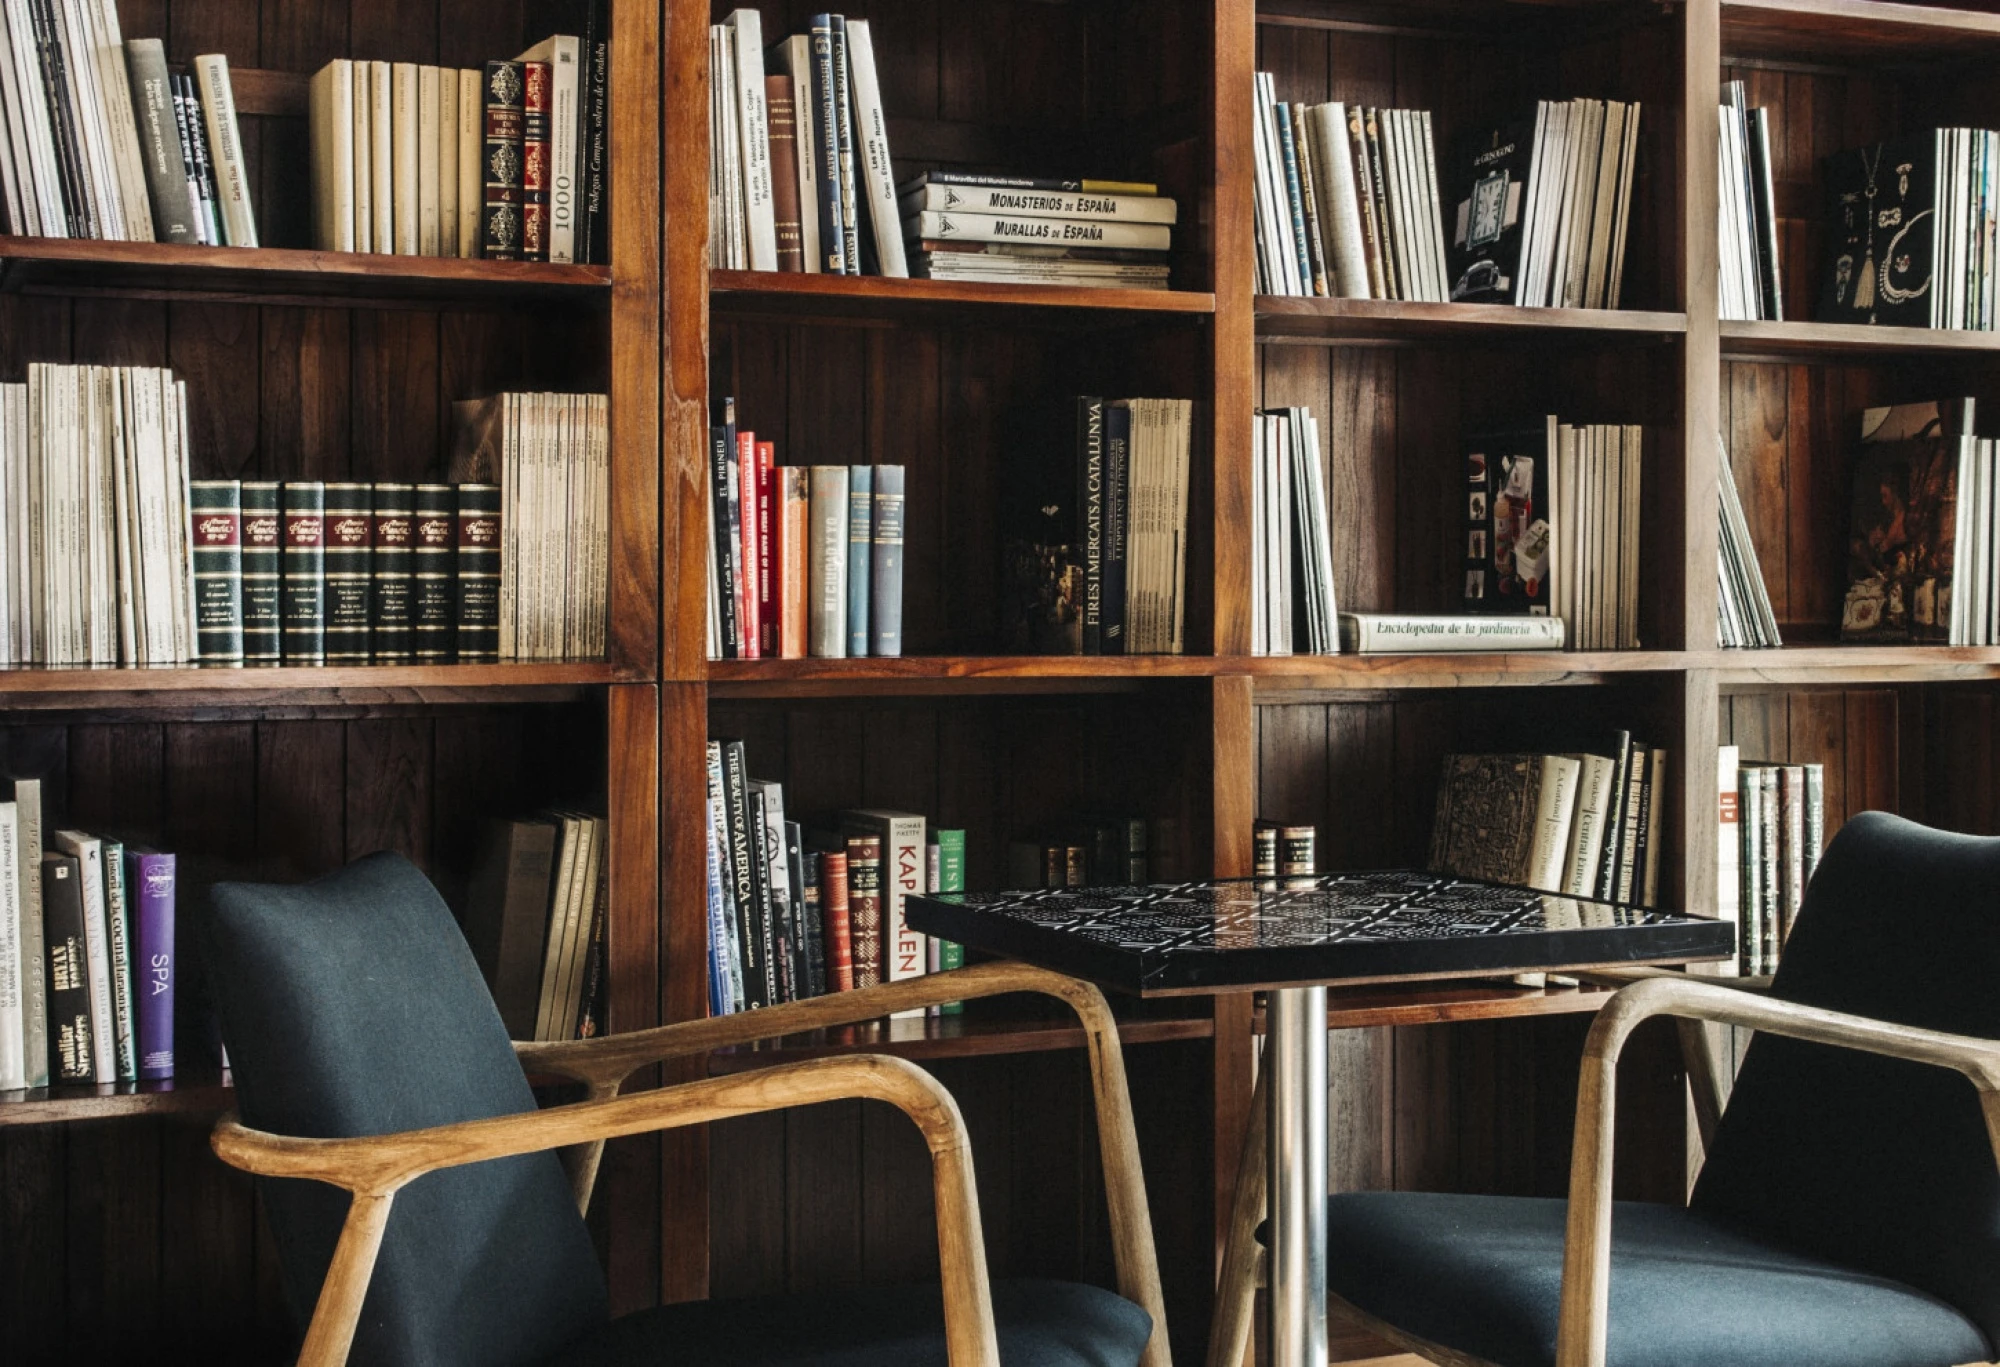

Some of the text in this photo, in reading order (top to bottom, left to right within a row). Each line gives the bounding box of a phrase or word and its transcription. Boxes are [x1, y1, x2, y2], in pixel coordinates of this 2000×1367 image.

[593, 86, 602, 96] de
[502, 191, 510, 200] 4
[555, 175, 571, 231] 1000
[990, 193, 1116, 214] MONASTERIOS DE ESPAÑA
[994, 221, 1103, 240] MURALLAS DE ESPAÑA
[1089, 403, 1101, 491] CATALUNYA
[717, 440, 728, 498] EL PIRINEU
[1089, 493, 1100, 504] A
[1088, 506, 1100, 572] MERCATS
[1088, 585, 1098, 626] FIRES
[1377, 622, 1444, 636] Enciclopedia
[1448, 623, 1461, 634] de
[1466, 623, 1476, 634] la
[728, 752, 738, 775] THE
[730, 777, 742, 818] BEAUTY
[734, 819, 743, 832] OF
[1580, 813, 1592, 854] Central
[108, 850, 118, 888] Historia
[733, 834, 751, 902] AMERICA
[110, 891, 119, 903] de
[112, 916, 124, 962] cocina
[32, 956, 42, 1033] PICASSO
[152, 955, 168, 995] SPA
